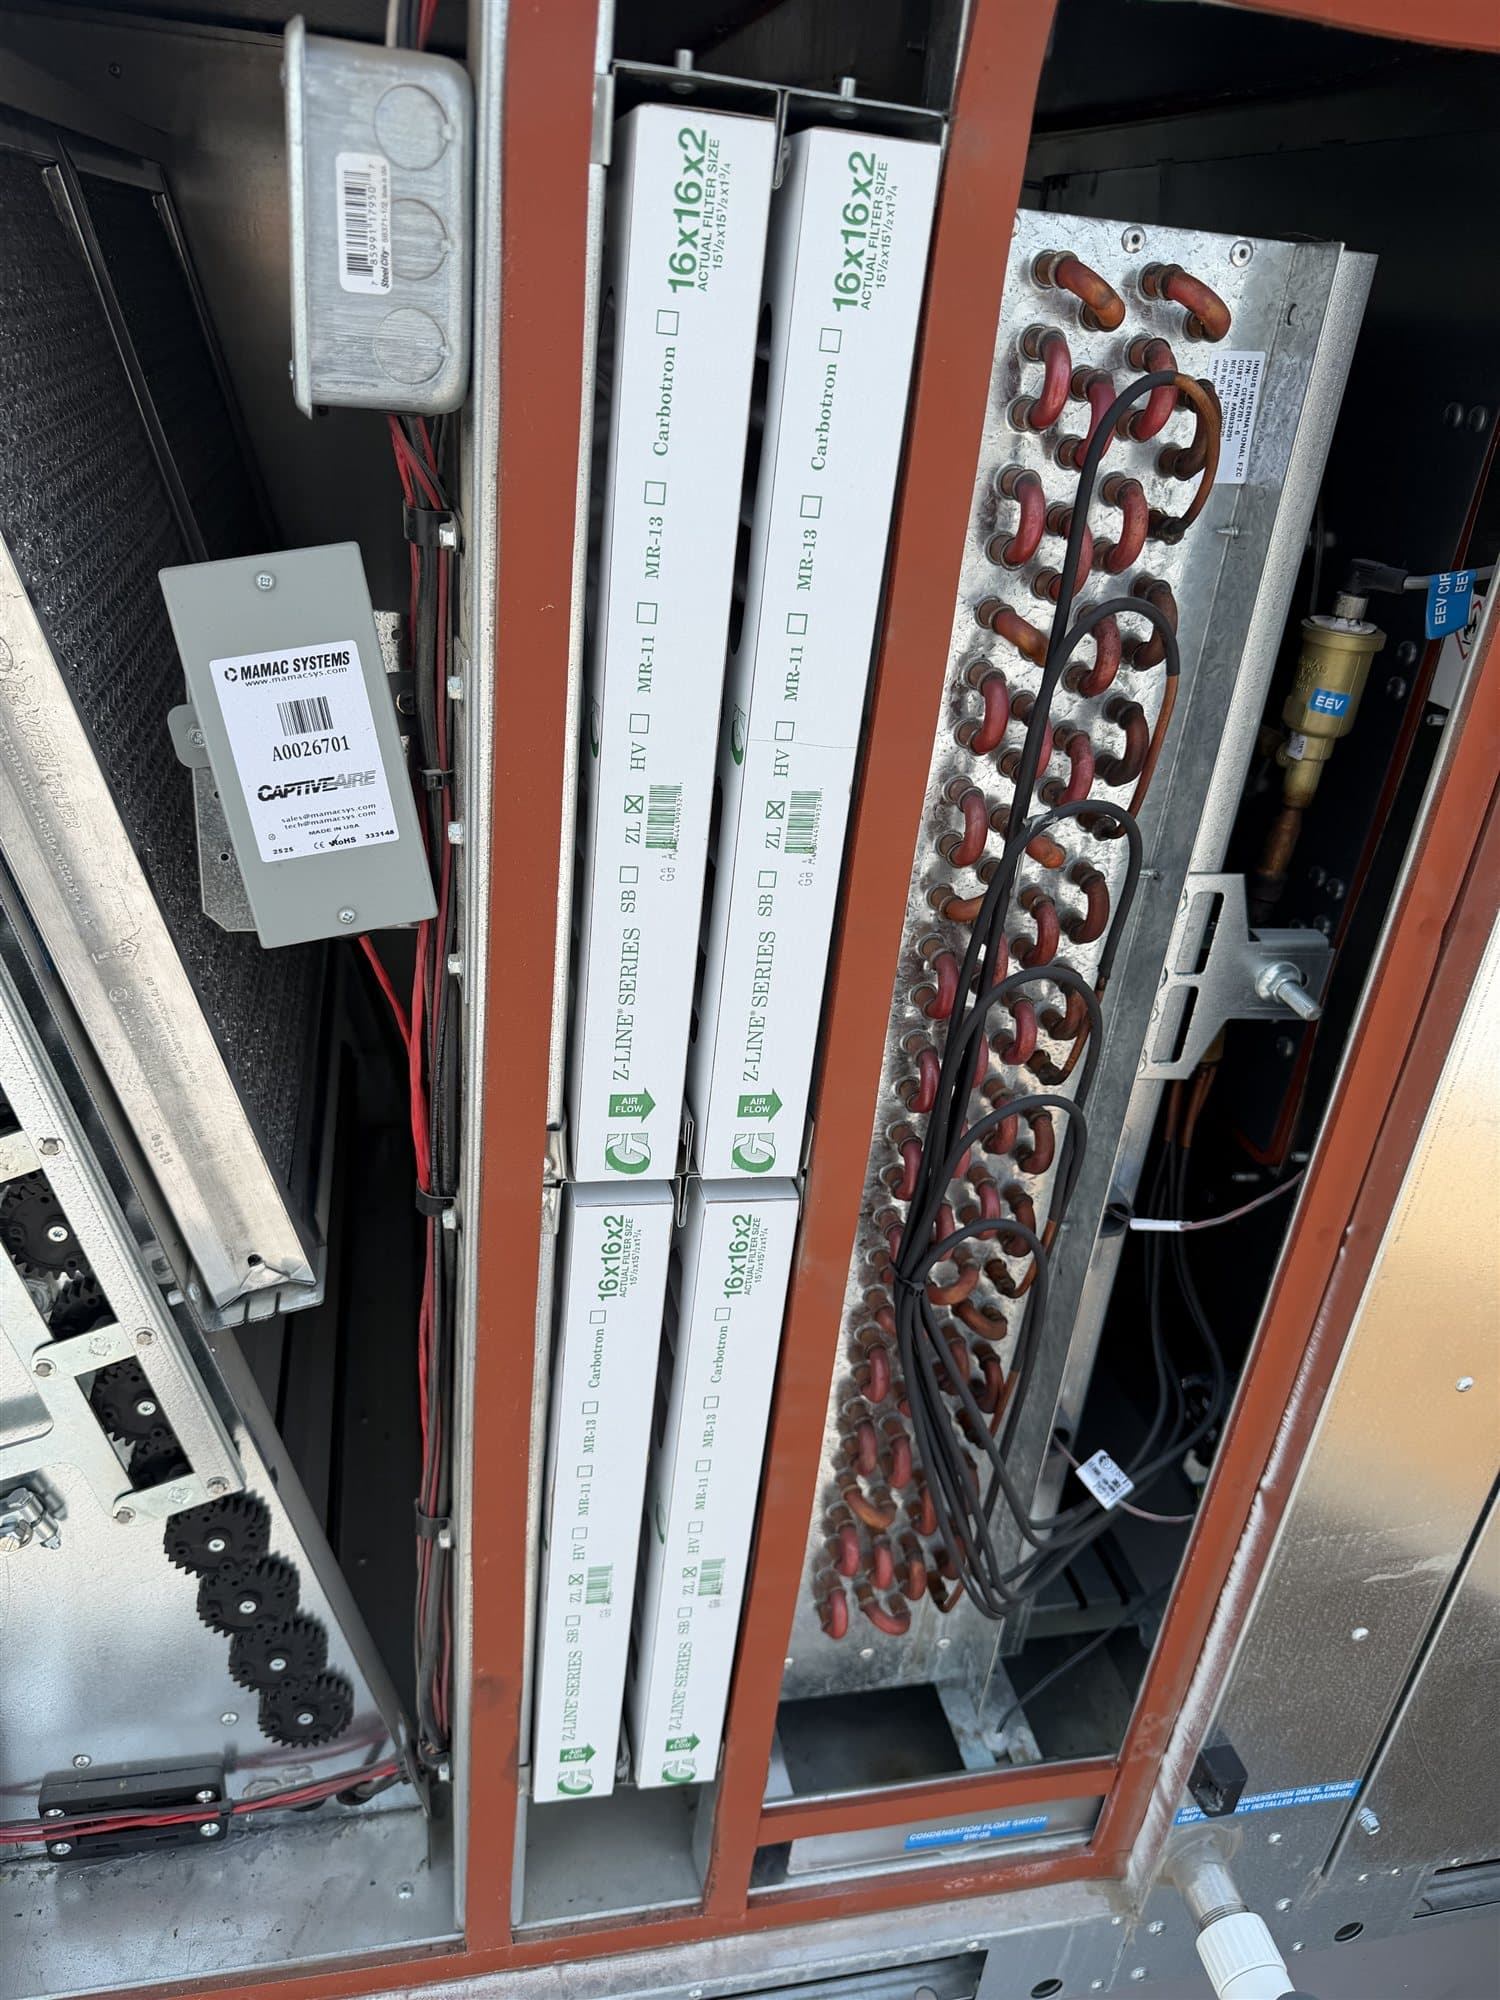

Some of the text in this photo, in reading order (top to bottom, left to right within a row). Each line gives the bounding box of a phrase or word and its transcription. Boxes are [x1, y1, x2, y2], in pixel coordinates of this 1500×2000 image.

[367, 187, 377, 222] 17950
[668, 128, 707, 293] 16x16x2
[698, 139, 720, 292] ACTUAL FILTER SIZE
[832, 151, 876, 311] 16x16x2
[861, 161, 888, 310] ACTUAL FILTER SIZE
[369, 230, 378, 265] 85991
[380, 267, 390, 288] Steel
[653, 346, 676, 456] Carbotron
[811, 363, 837, 471] Carbotron
[1236, 360, 1260, 477] INDUS INTERNATIONAL FZC
[645, 516, 663, 579] MR-13
[797, 529, 817, 592] MR-13
[1454, 569, 1469, 593] EEV
[1435, 598, 1447, 625] EEV
[240, 651, 350, 680] MAMAC SYSTEMS
[245, 667, 347, 687] www.mamacsys.com
[637, 635, 655, 693] MR-11
[784, 645, 803, 702] MR-11
[1315, 695, 1344, 711] EEV
[272, 735, 350, 762] A0026701
[630, 742, 647, 772] HV
[773, 748, 790, 778] HV
[281, 803, 376, 824] sales@mamacsys.com
[284, 810, 376, 830] tech@mamacsys.com
[308, 828, 332, 836] MADE
[625, 821, 641, 844] ZL
[765, 826, 782, 850] ZL
[620, 890, 636, 913] SB
[757, 894, 774, 917] SB
[619, 927, 640, 1006] SERIES
[751, 931, 776, 1008] SERIES
[615, 1105, 643, 1113] FLOW
[621, 1097, 638, 1105] AIR
[744, 1105, 770, 1114] FLOW
[749, 1097, 766, 1105] AIR
[598, 1215, 624, 1301] 16x16x2
[619, 1218, 634, 1298] ACTUAL FILTER SIZE
[724, 1214, 752, 1299] 16x16x2
[743, 1217, 761, 1295] ACTUAL FILTER SIZE
[588, 1328, 604, 1388] Carbotron
[711, 1325, 728, 1384] Carbotron
[583, 1419, 596, 1454] MR-13
[703, 1413, 716, 1448] MR-13
[578, 1483, 591, 1516] MR-11
[695, 1477, 709, 1511] MR-11
[572, 1543, 585, 1561] HV
[687, 1536, 700, 1554] HV
[570, 1588, 582, 1603] ZL
[682, 1583, 695, 1596] ZL
[566, 1628, 579, 1643] SB
[678, 1619, 691, 1634] SB
[565, 1649, 583, 1696] SERIES
[675, 1641, 693, 1687] SERIES
[1177, 1814, 1199, 1823] TRAP
[1251, 1798, 1293, 1810] INSTALLED
[1294, 1796, 1310, 1804] FOR
[1311, 1791, 1353, 1802] DRAINAGE.
[1238, 1791, 1295, 1805] ONDENSATION
[1323, 1782, 1356, 1792] ENSURE
[909, 1815, 1048, 1841] CONDENSATION FLOAT SWITCH
